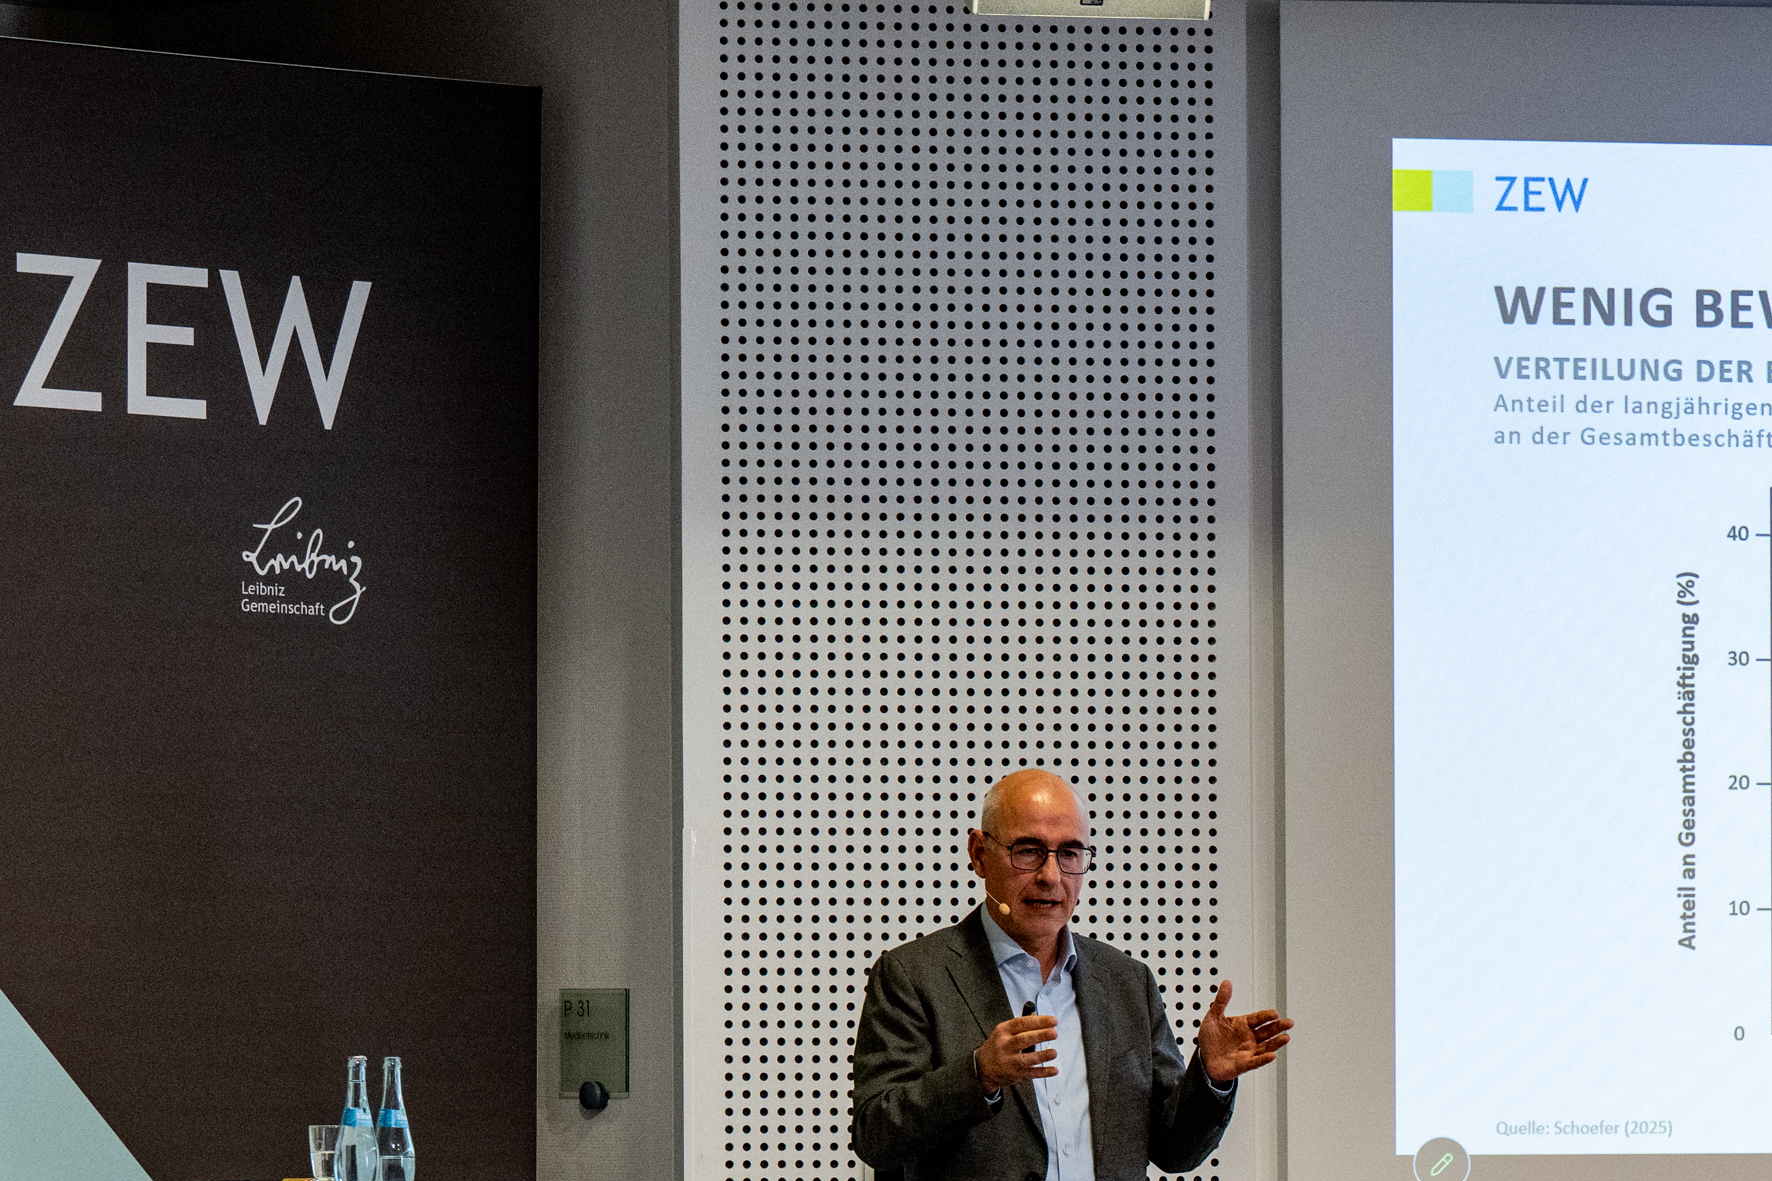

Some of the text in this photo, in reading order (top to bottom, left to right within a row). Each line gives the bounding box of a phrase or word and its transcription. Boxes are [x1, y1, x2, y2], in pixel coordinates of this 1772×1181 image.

[1494, 175, 1589, 213] ZEW
[1493, 285, 1673, 329] WENIG
[12, 252, 373, 431] ZEW
[1493, 355, 1683, 383] VERTEILUNG
[1696, 359, 1754, 384] DER
[1493, 393, 1565, 414] Anteil
[1574, 393, 1615, 415] der
[1624, 394, 1772, 421] langjährigen
[1494, 430, 1521, 445] an
[1531, 425, 1571, 446] der
[1726, 525, 1750, 542] 40
[241, 580, 286, 597] Leibniz
[240, 598, 326, 616] Gemeinschaft
[1727, 650, 1750, 667] 30
[1675, 571, 1700, 951] Anteil an Gesamtbeschäftigung (%)
[1727, 774, 1751, 791] 20
[1729, 899, 1751, 917] 10
[563, 999, 590, 1018] P 31
[1733, 1025, 1746, 1042] 0
[1495, 1119, 1673, 1139] Quelle: Schoefer (2025)
